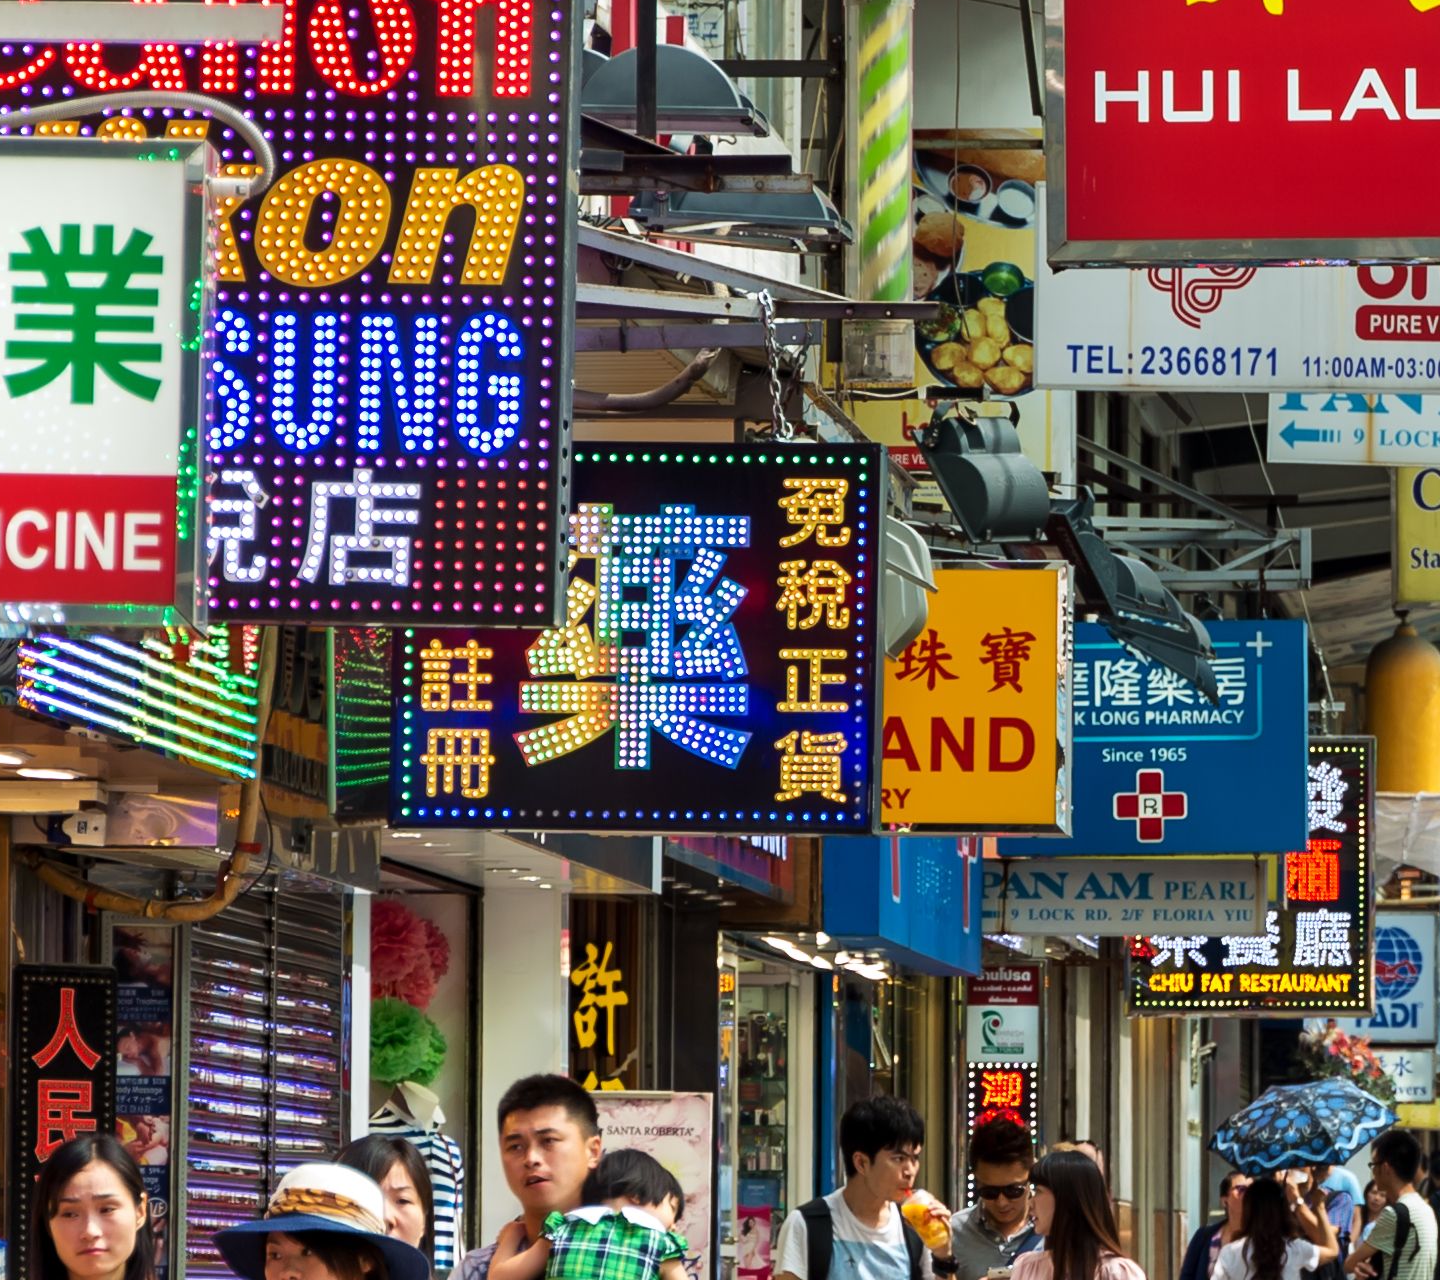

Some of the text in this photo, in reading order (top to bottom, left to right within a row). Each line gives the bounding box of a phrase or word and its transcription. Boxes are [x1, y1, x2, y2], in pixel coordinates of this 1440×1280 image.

[1088, 67, 1242, 123] HUI
[1369, 314, 1423, 335] PURE
[1353, 428, 1366, 446] 9
[894, 626, 1037, 695] 珠寶
[419, 638, 496, 800] 註冊
[1092, 710, 1245, 726] LONG PHARMACY
[1102, 747, 1188, 763] Since 1965
[982, 872, 1256, 902] PAN AM PEARL
[1028, 908, 1075, 922] LOCK
[1085, 908, 1112, 922] RD.
[1121, 907, 1145, 922] 2/F
[1152, 908, 1214, 923] FLORIA
[1224, 908, 1254, 922] YIU
[1201, 973, 1234, 993] FAT
[1240, 973, 1353, 994] RESTAURANT
[606, 1125, 643, 1137] SANTA
